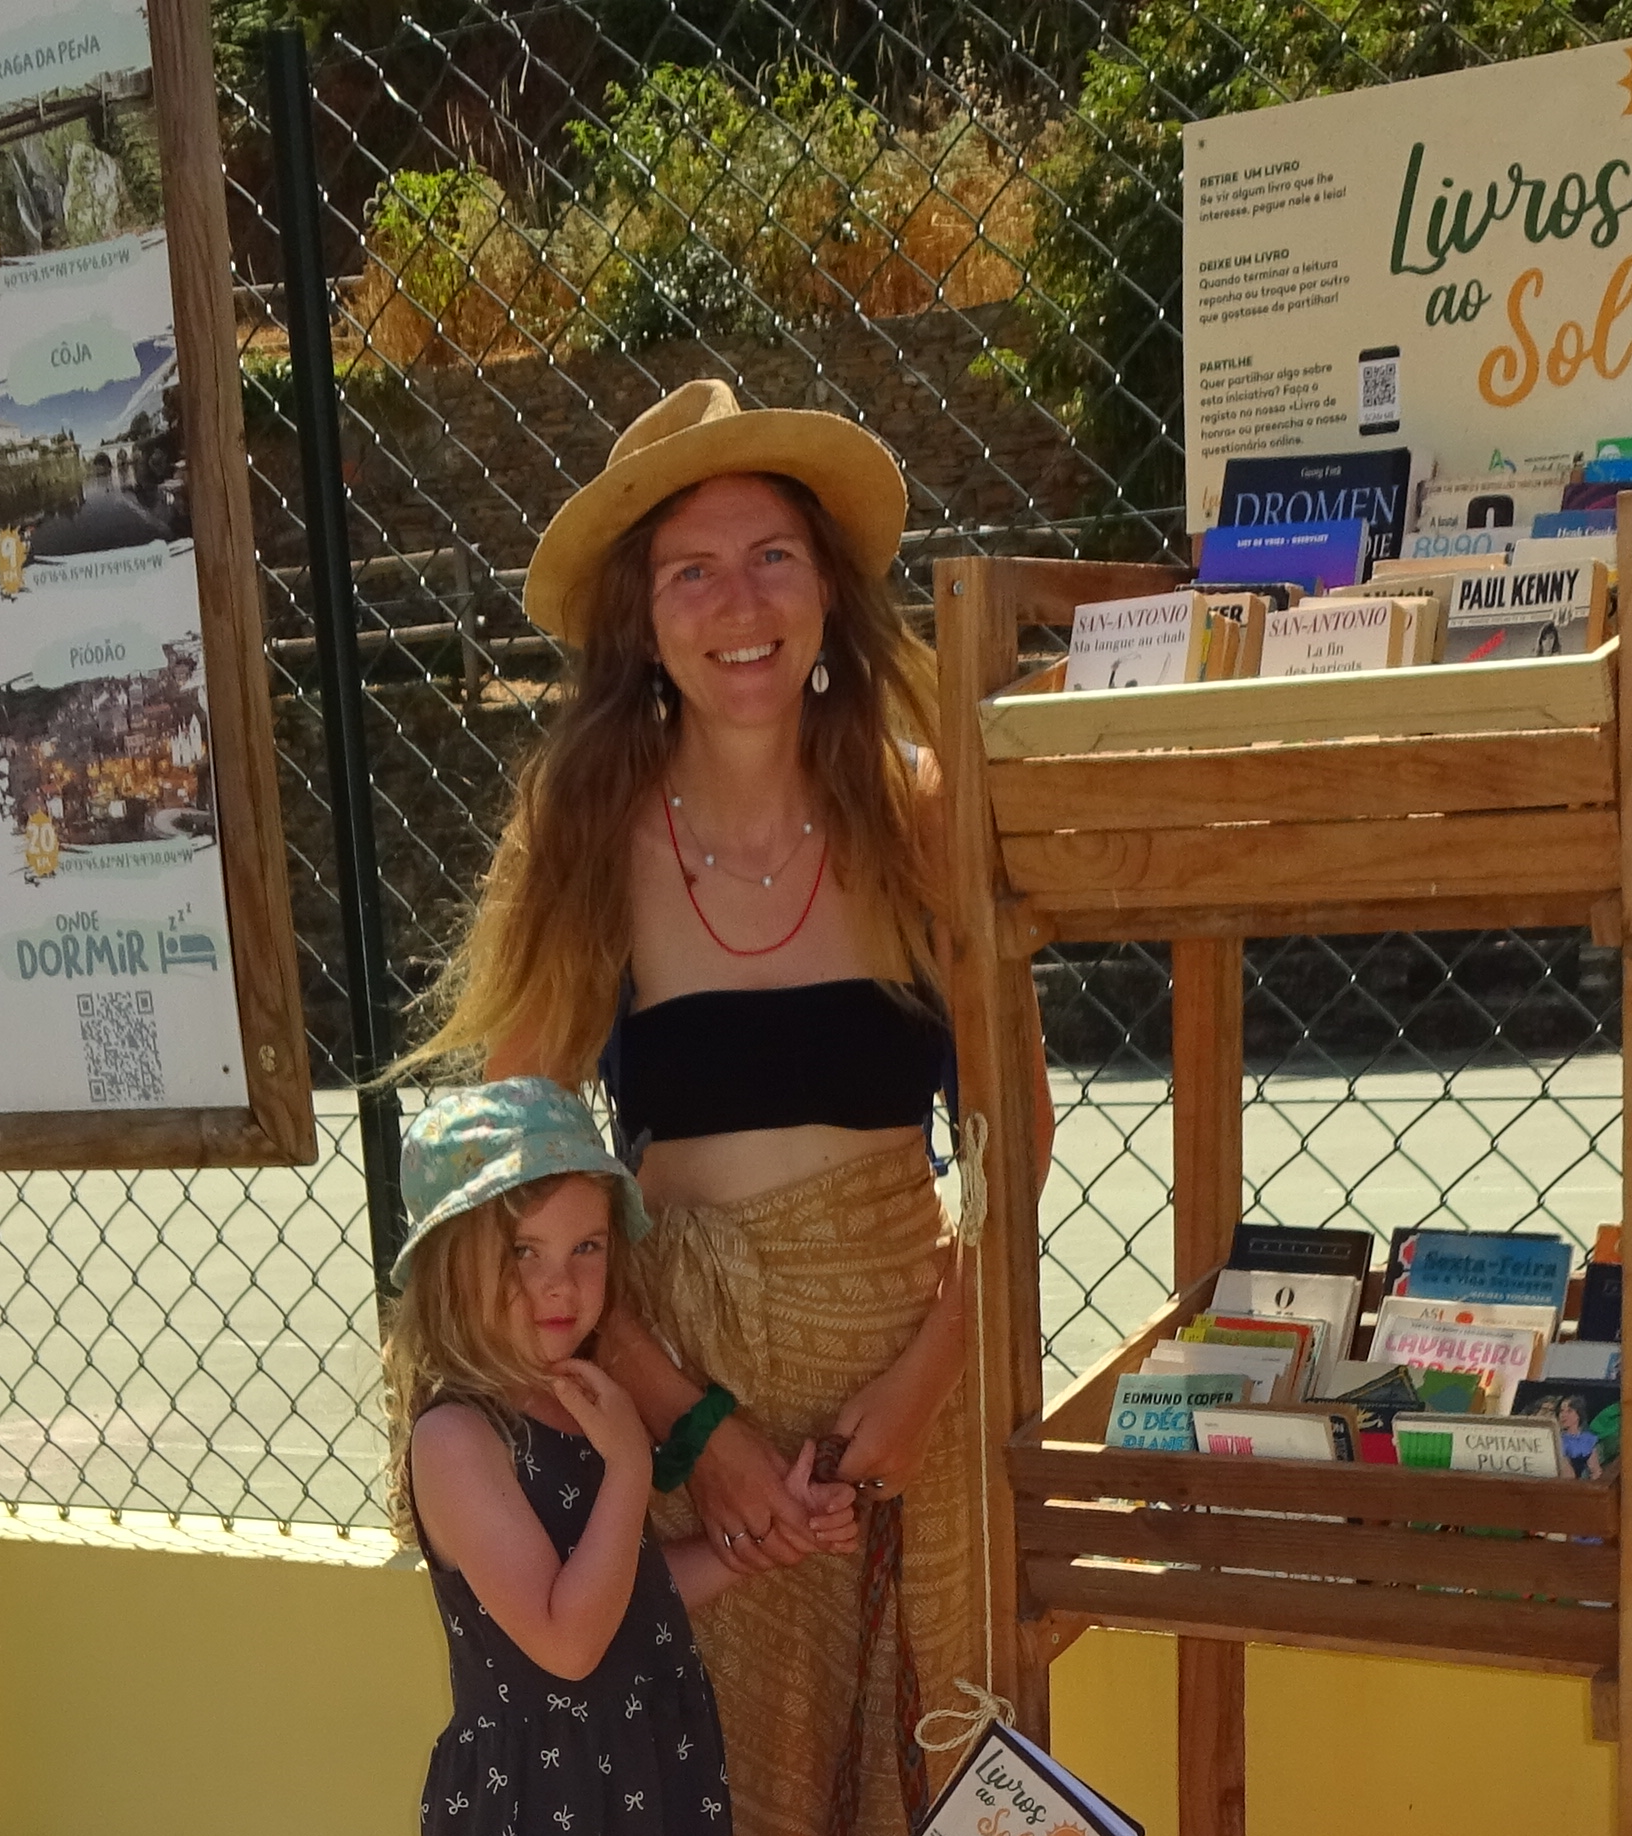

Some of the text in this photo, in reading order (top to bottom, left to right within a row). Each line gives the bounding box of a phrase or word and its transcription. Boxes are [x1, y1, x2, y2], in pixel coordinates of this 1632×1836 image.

[36, 47, 56, 69] DA
[58, 34, 101, 64] PENA
[1200, 160, 1301, 188] RETIRE UM LIVRO
[1200, 172, 1334, 207] Se vir algum livro que lhe
[1252, 200, 1286, 217] pegue
[1288, 193, 1311, 206] nele
[1323, 186, 1347, 200] leia!
[1199, 248, 1290, 273] DEIXE UM LIVRO
[1199, 259, 1339, 290] Quando terminar a leitura
[1199, 274, 1351, 308] reponha ou troque por outro
[1425, 274, 1493, 327] ao
[1199, 291, 1340, 325] que gostasse de partilhar!
[50, 340, 93, 368] CÔJA
[1199, 356, 1253, 374] PARTILHE
[1200, 362, 1333, 391] Quer partilhar algo sobre
[1200, 394, 1224, 407] esta
[1225, 386, 1280, 403] iniciativa?
[1283, 384, 1309, 398] Faça
[1200, 410, 1237, 425] registo
[1239, 408, 1253, 418] no
[1255, 403, 1286, 416] nosso
[1323, 396, 1337, 407] de
[1238, 425, 1252, 436] ou
[1254, 418, 1304, 436] preencha
[1315, 413, 1348, 426] nosso
[1201, 439, 1267, 459] questionário
[1458, 568, 1581, 611] PAUL KENNY
[1076, 603, 1188, 635] SAN-ANTONIO
[1269, 605, 1388, 637] SAN-ANTONIO
[1095, 636, 1135, 655] langue
[1139, 636, 1153, 647] au
[1306, 642, 1344, 659] La fin
[27, 821, 56, 853] 20
[56, 910, 100, 933] ONDE
[1123, 1391, 1233, 1406] EDMUND COOPER
[1118, 1410, 1137, 1430] O
[1465, 1433, 1543, 1453] CAPITAINE
[1477, 1453, 1534, 1474] PUCE
[975, 1748, 1048, 1826] Livros
[975, 1786, 996, 1808] ao
